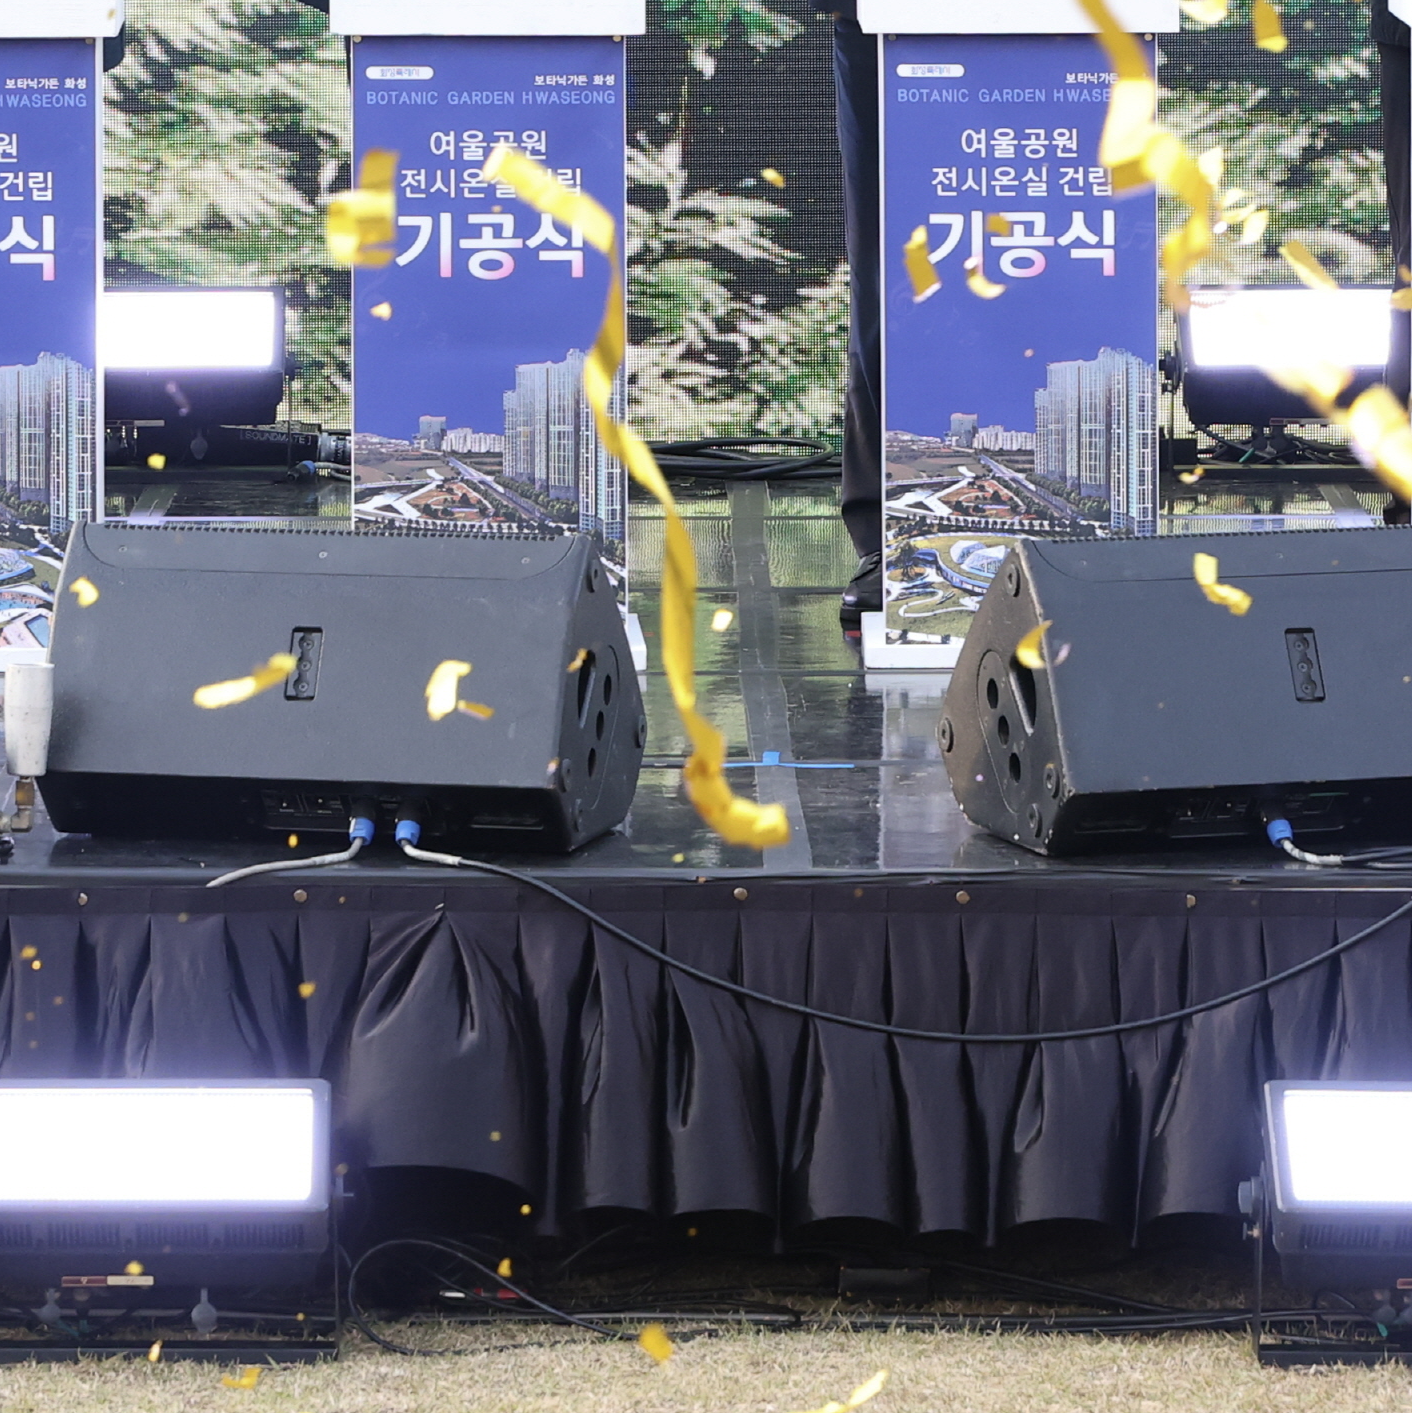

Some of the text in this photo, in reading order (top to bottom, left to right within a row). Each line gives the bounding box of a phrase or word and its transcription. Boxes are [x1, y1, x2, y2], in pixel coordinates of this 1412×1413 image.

[5, 78, 86, 89] 보타닉가든 화성
[534, 74, 615, 86] 보타닉가든 화성
[1065, 73, 1118, 84] 보타닉가든
[367, 91, 615, 104] BOTANIC GARDEN HWASEONG
[898, 89, 1112, 102] BOTANIC GARDEN HWASE
[961, 128, 1077, 158] 여울공원
[0, 172, 53, 201] 건립
[536, 168, 581, 197] 립
[932, 167, 1112, 196] 전시온실 건립
[396, 212, 584, 280] 기공식
[928, 210, 1115, 277] 기공식
